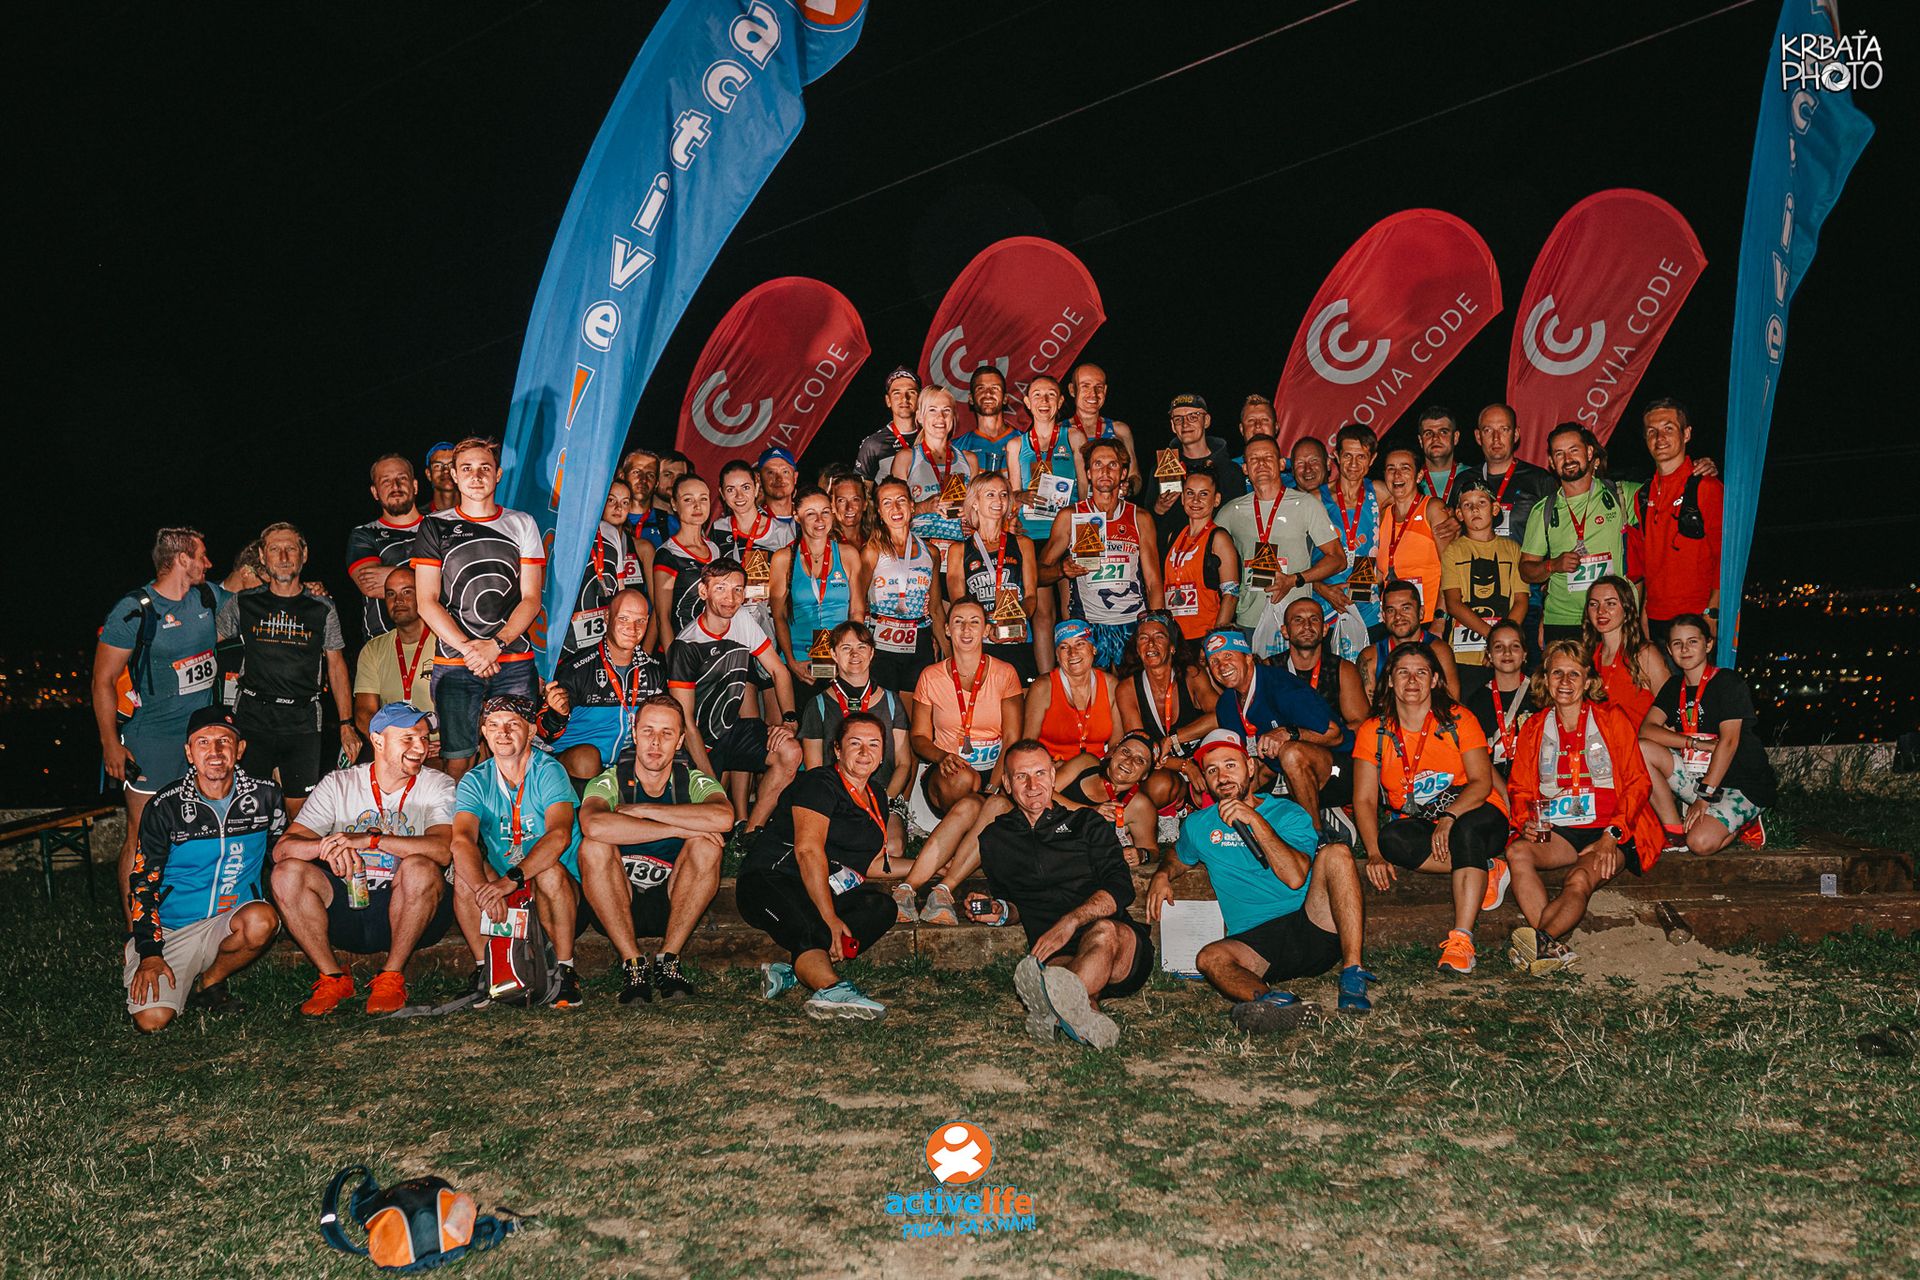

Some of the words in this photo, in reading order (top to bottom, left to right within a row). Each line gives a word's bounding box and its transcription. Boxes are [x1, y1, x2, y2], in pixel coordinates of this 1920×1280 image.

[1628, 257, 1683, 335] CODE
[1411, 292, 1479, 363] CODE
[1029, 306, 1085, 373] CODE
[799, 343, 850, 414] CODE
[1092, 564, 1125, 581] 221
[1574, 562, 1608, 582] 217
[879, 627, 916, 645] 408
[185, 660, 213, 684] 138
[967, 744, 1001, 763] 316
[624, 861, 668, 882] 130
